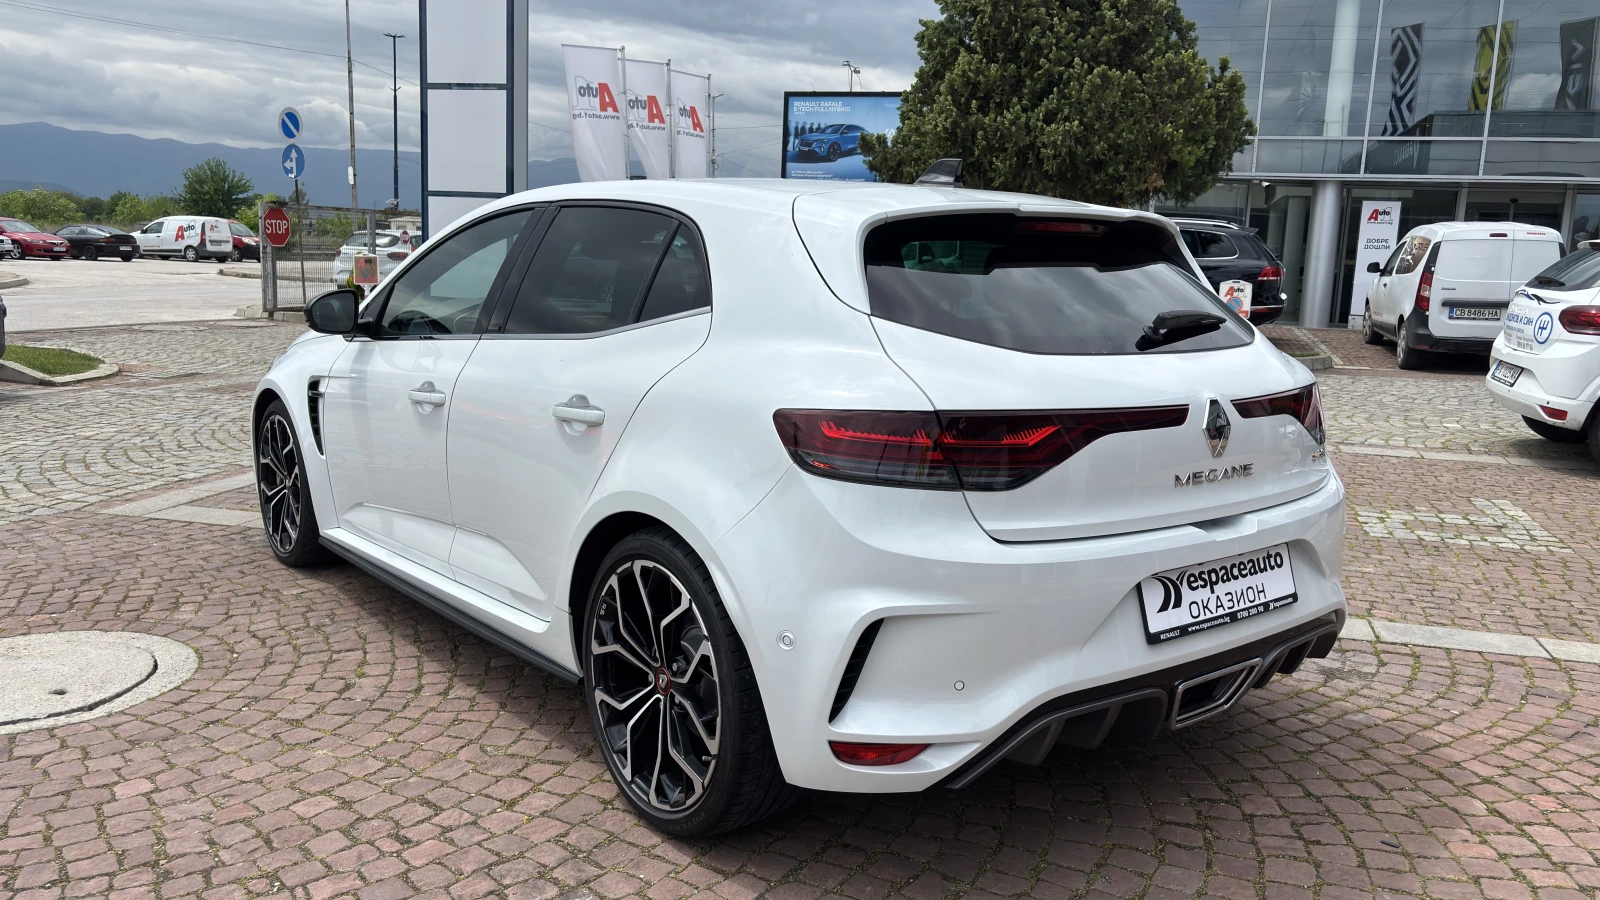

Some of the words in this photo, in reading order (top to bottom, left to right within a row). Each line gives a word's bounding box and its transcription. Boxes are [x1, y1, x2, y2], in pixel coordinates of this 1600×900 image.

[265, 219, 288, 234] STOP
[1455, 309, 1466, 317] CB
[1467, 309, 1486, 317] 8486
[1488, 310, 1498, 318] HA
[1175, 463, 1253, 488] MEGANE
[1186, 550, 1284, 594] espaceauto
[1189, 583, 1267, 619] ОКАЗИОН
[1160, 630, 1180, 640] RENAULT
[1187, 615, 1231, 632] www.espaceauto.bg
